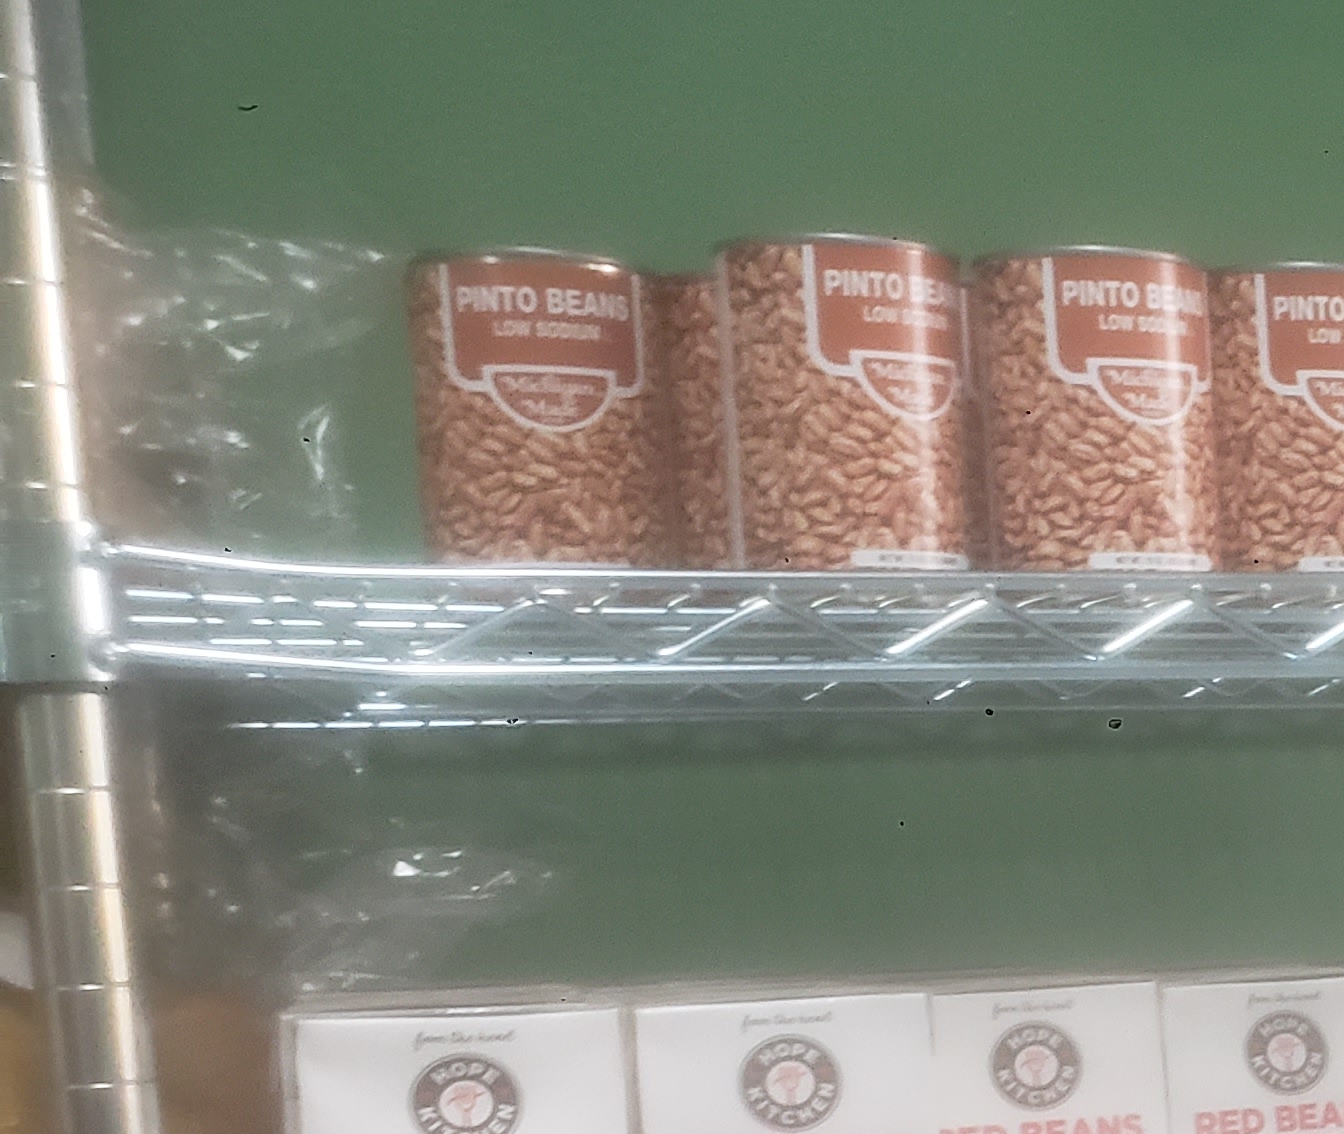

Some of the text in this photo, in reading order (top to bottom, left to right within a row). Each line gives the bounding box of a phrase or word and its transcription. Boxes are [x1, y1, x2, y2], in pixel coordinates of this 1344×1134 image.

[824, 269, 903, 301] PINTO
[1062, 281, 1140, 308] PINTO
[455, 286, 630, 321] PINTO BEANS
[430, 1061, 501, 1085] HOPE
